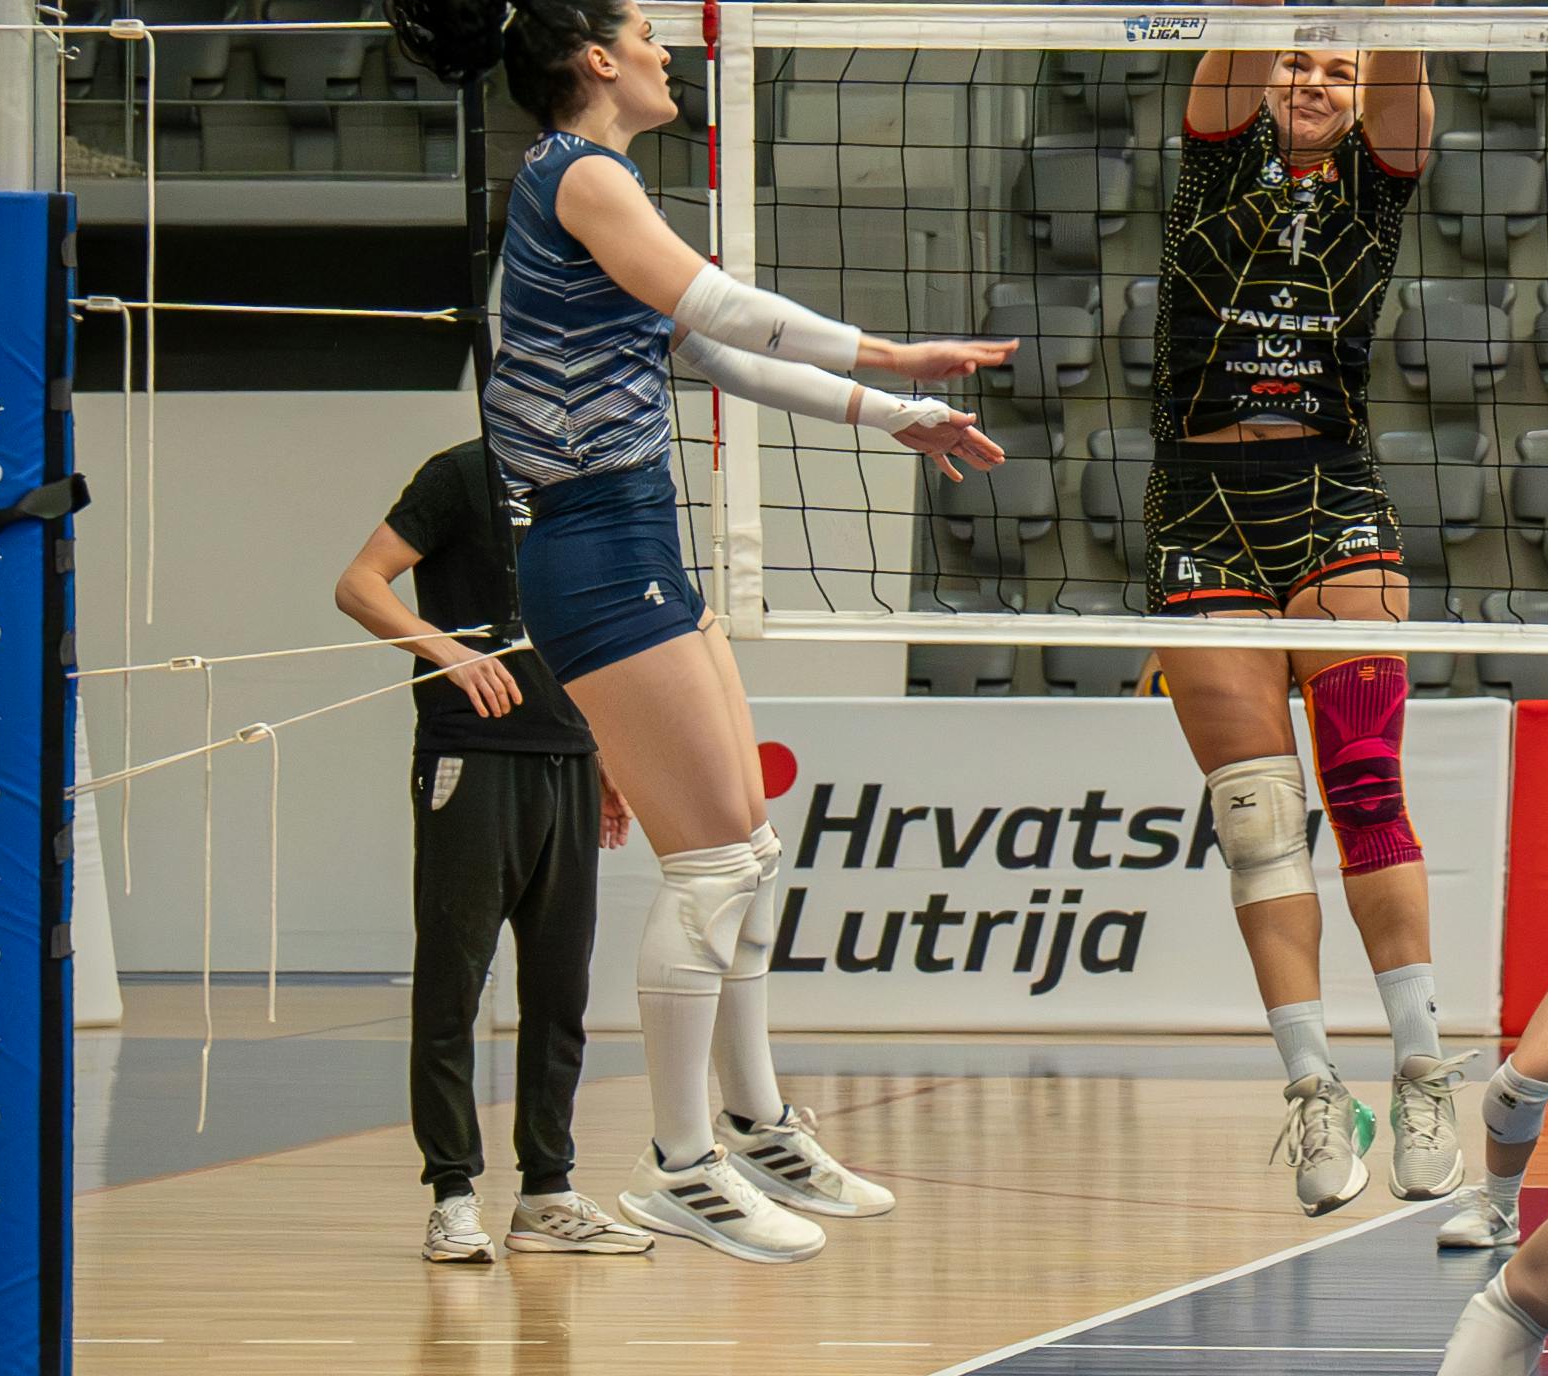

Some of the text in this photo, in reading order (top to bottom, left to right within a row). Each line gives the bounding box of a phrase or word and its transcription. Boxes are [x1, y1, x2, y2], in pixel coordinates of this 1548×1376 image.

[1152, 17, 1199, 28] SUPER
[1148, 29, 1180, 40] LIGA
[1278, 213, 1307, 265] 4
[1220, 307, 1341, 332] FAVBET
[1225, 359, 1324, 377] KONČAR
[769, 886, 1147, 997] Lutrija
